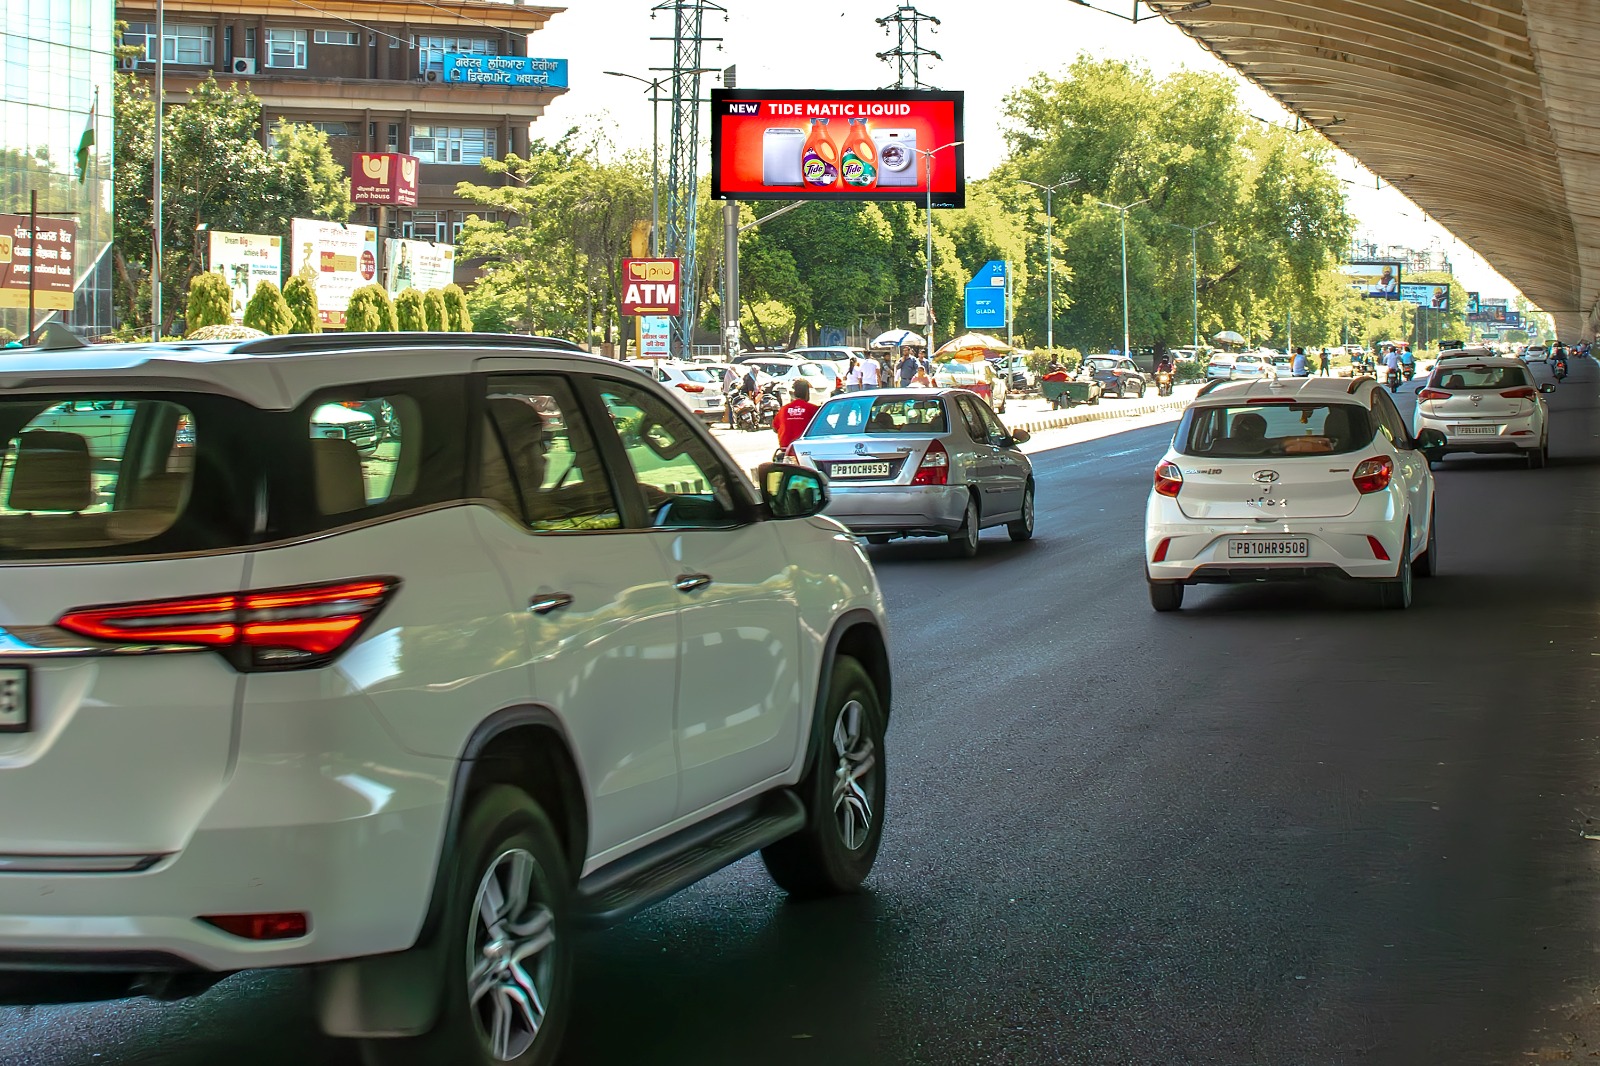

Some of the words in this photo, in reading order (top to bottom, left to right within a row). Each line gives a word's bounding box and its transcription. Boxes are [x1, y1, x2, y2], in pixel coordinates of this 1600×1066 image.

[729, 103, 758, 114] NEW
[768, 103, 803, 115] TIDE
[806, 103, 854, 116] MATIC
[858, 103, 911, 116] LIQUID
[806, 164, 823, 175] Tide
[845, 164, 861, 175] Tide
[355, 192, 368, 200] pnb
[370, 192, 390, 200] house
[624, 284, 676, 304] ATM
[837, 463, 888, 475] PB10CH9593
[1236, 542, 1305, 554] PB10HR9508
